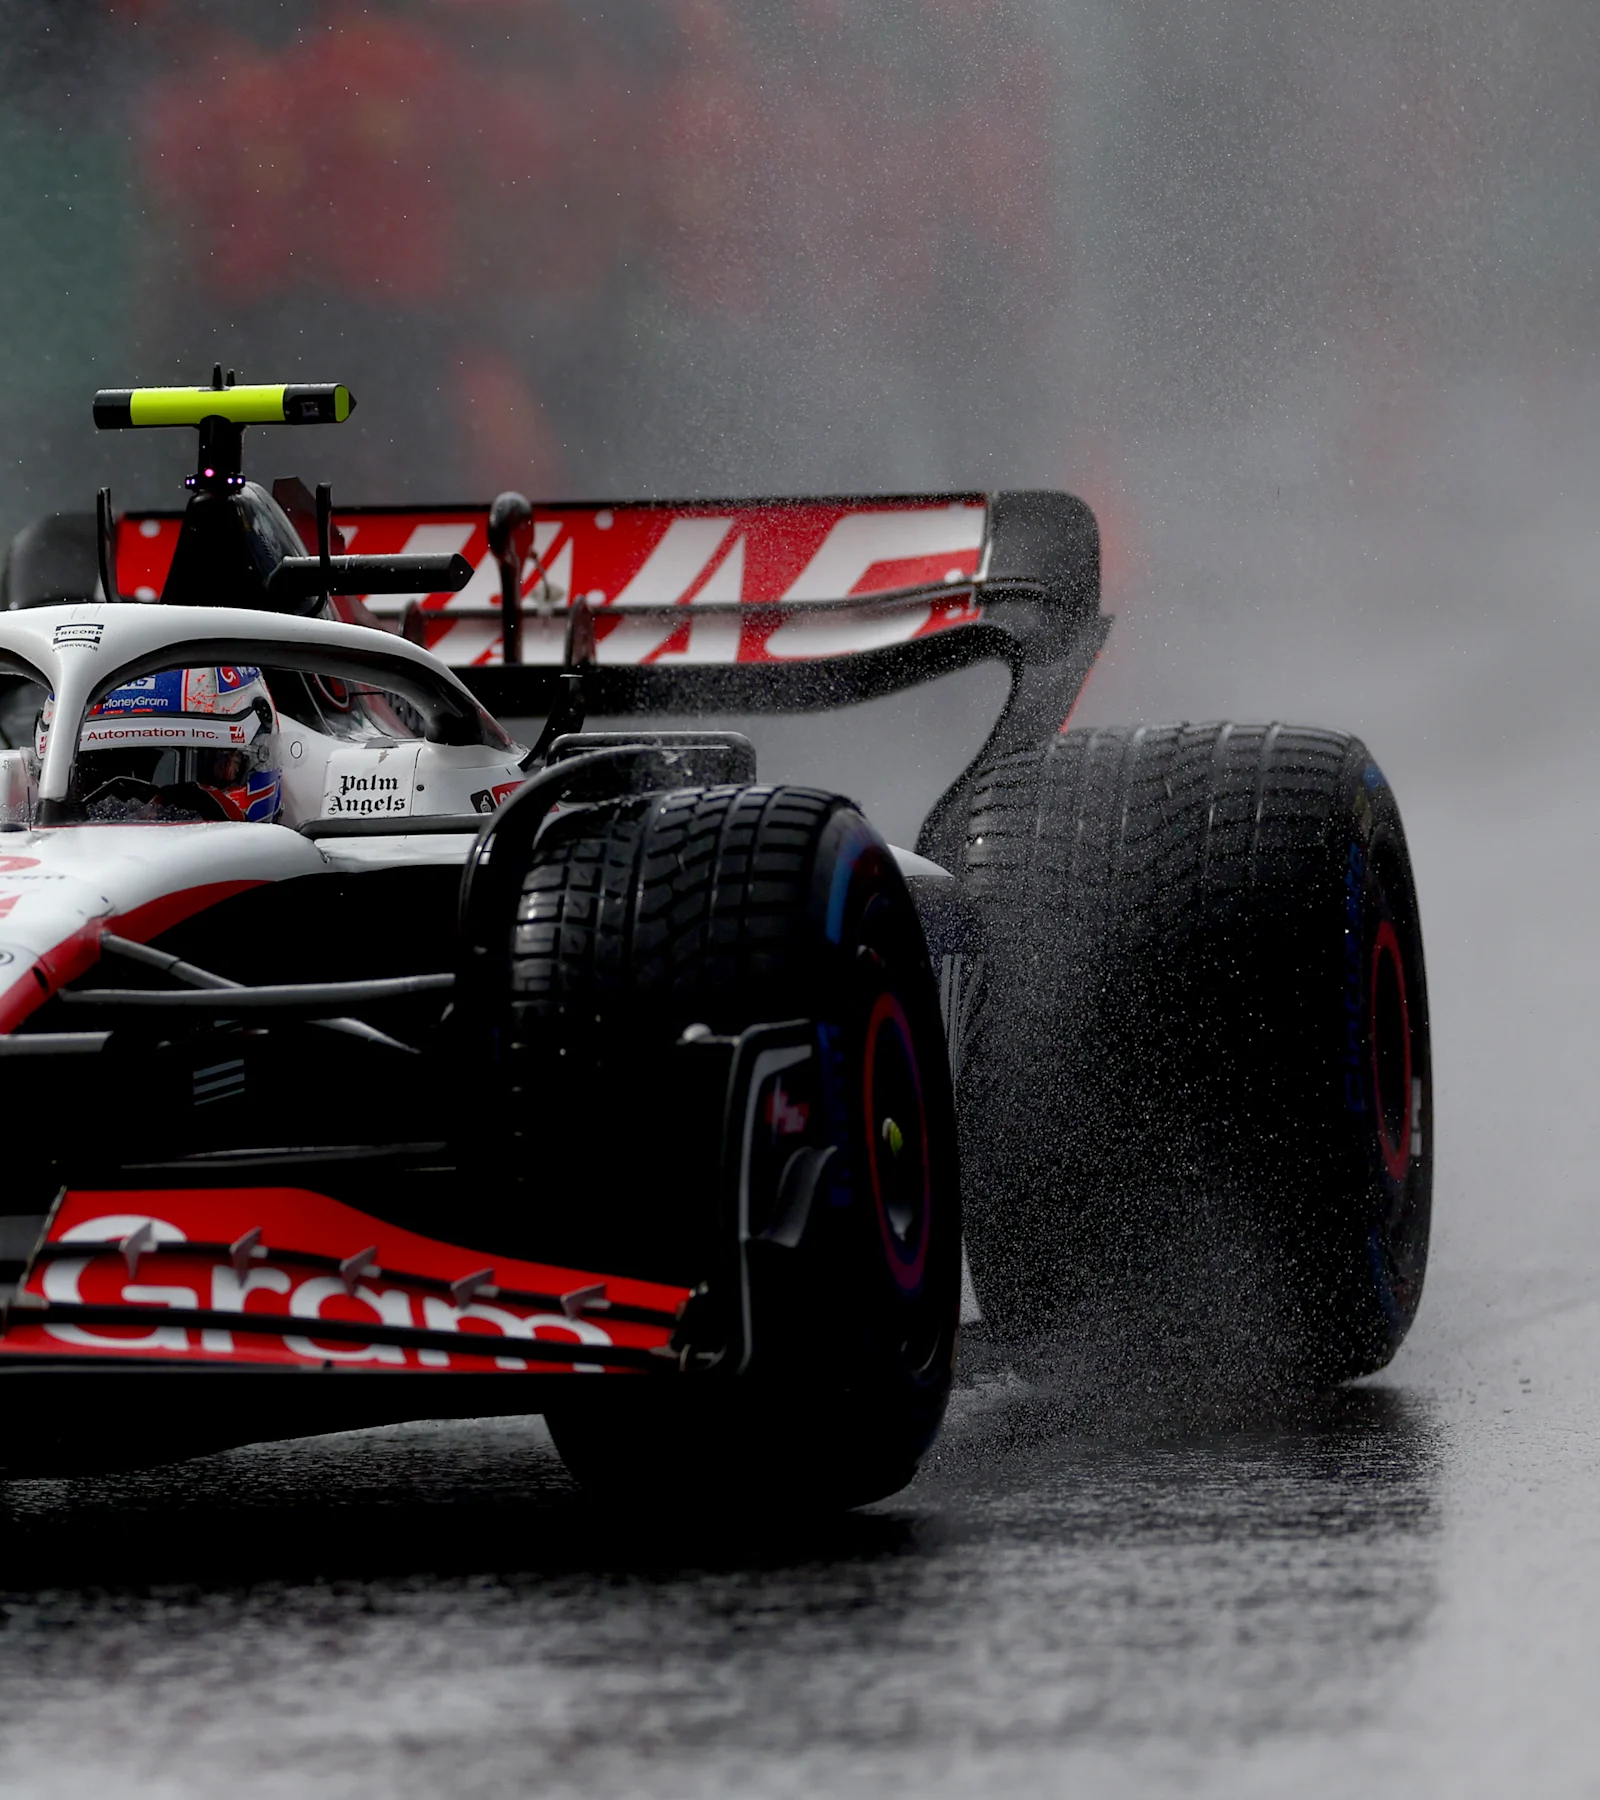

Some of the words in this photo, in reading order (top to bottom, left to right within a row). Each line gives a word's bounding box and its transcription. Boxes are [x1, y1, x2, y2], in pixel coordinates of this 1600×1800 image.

[102, 696, 169, 709] MoneyGram
[87, 728, 186, 741] Automation
[191, 728, 219, 739] Inc.
[339, 774, 399, 796] Palm
[328, 795, 407, 815] Angels
[42, 1213, 615, 1373] Gram
